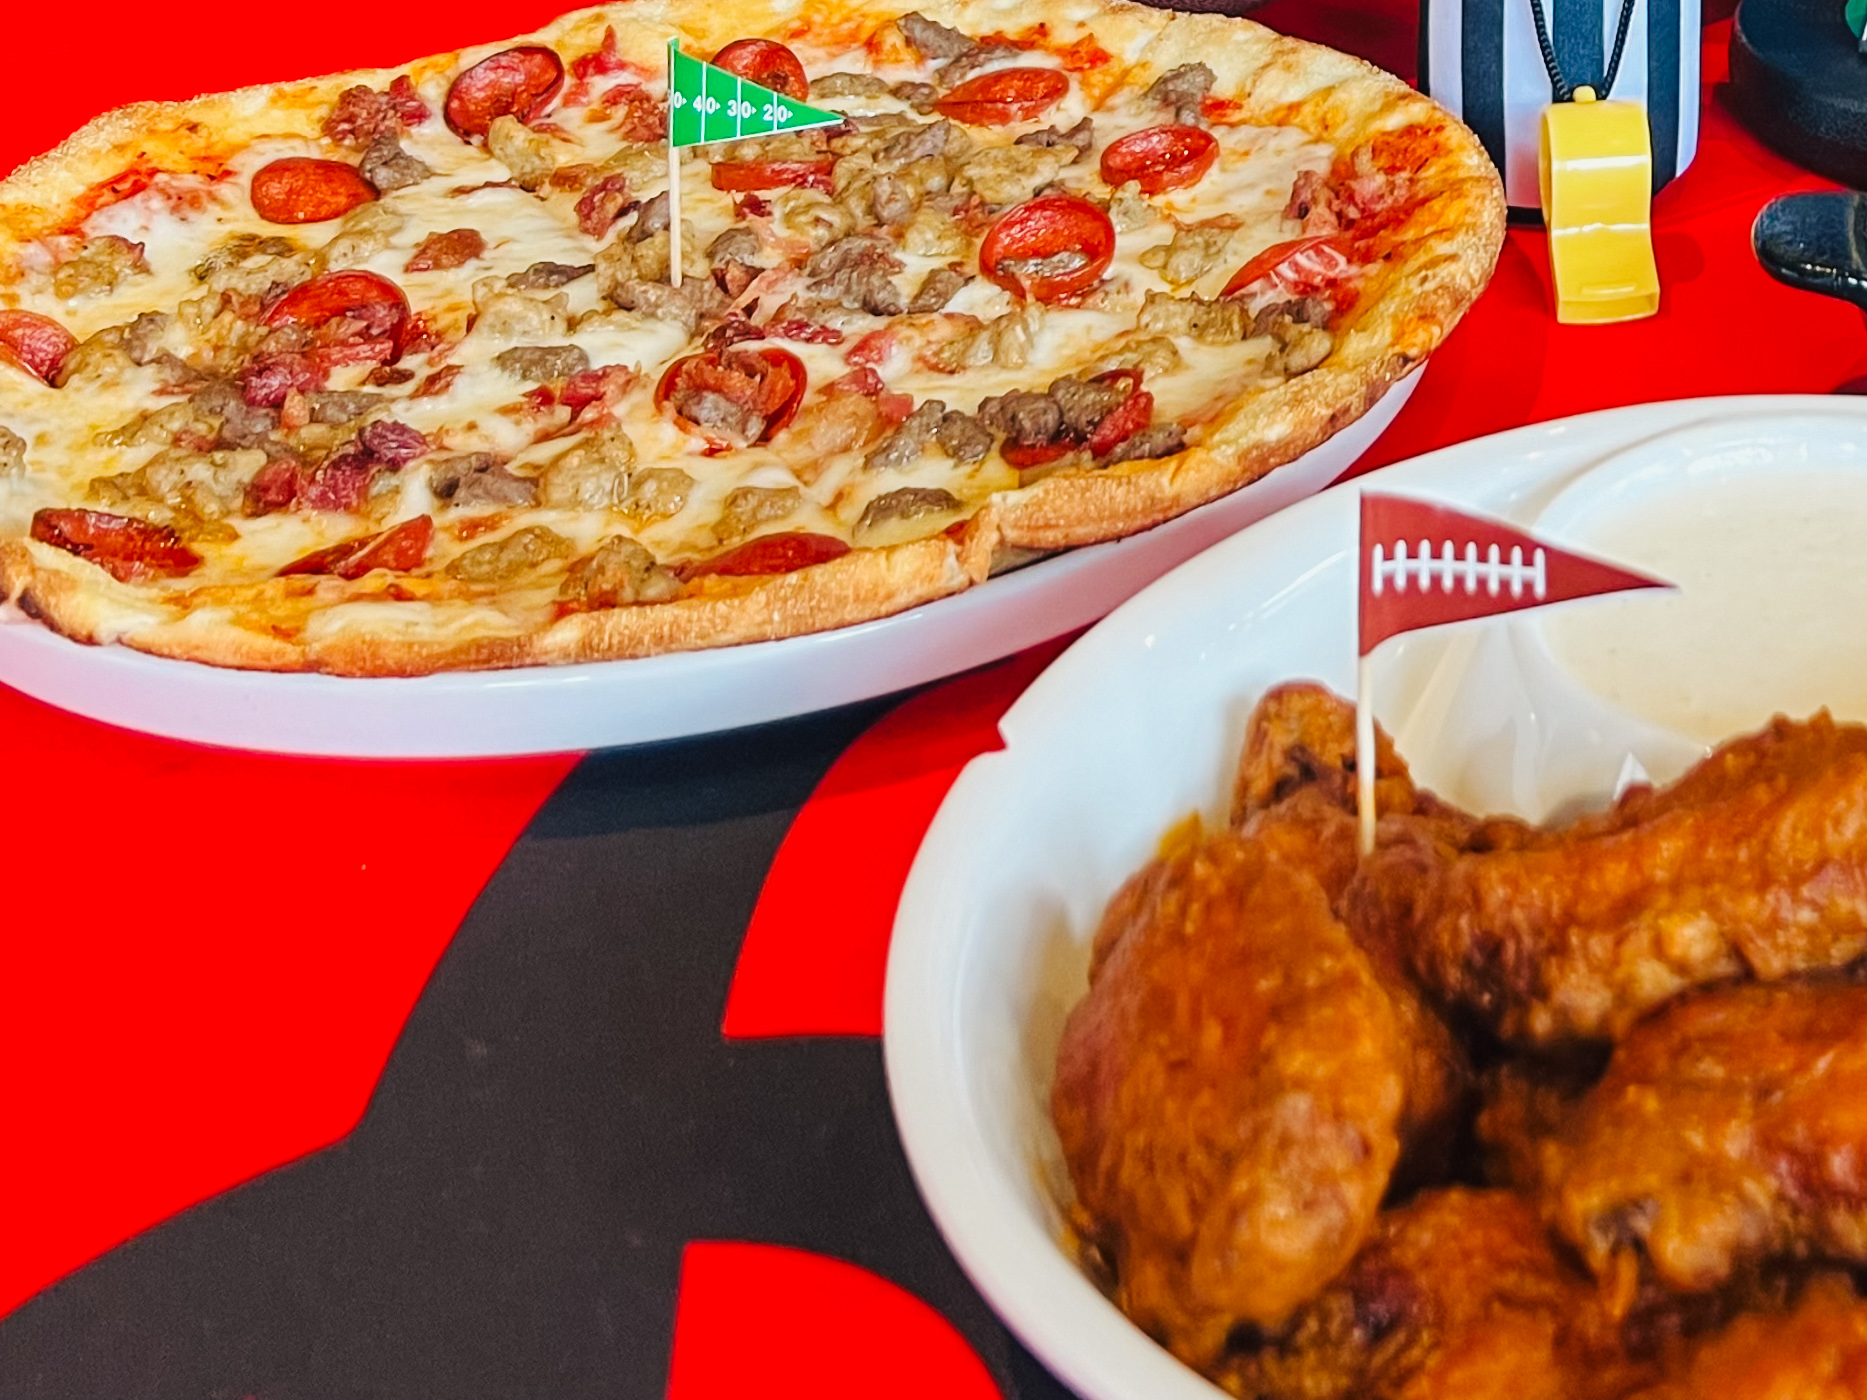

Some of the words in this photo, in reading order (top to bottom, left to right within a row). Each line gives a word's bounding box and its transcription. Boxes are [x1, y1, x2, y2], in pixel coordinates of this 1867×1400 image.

[693, 95, 716, 114] 40
[727, 99, 750, 119] 30
[762, 103, 787, 123] 20
